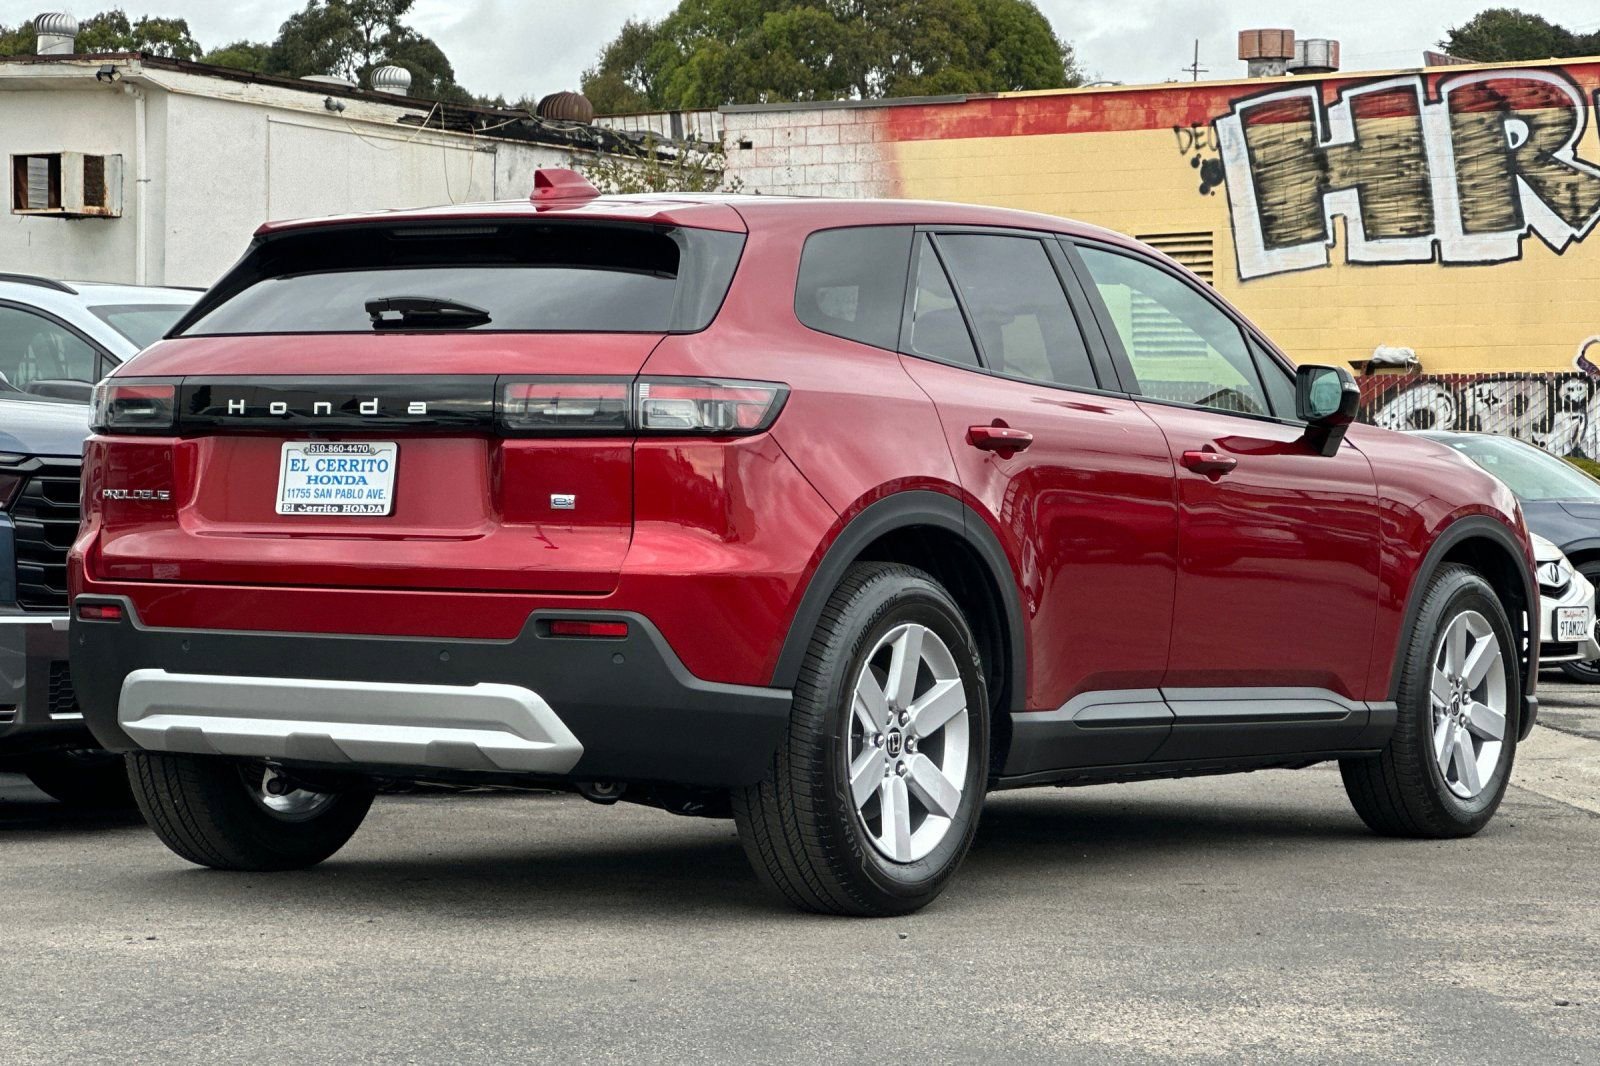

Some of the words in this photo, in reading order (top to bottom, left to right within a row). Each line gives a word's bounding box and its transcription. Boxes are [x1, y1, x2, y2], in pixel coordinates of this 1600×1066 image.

[227, 397, 427, 415] Honda
[310, 444, 368, 453] 510-860-4470
[290, 458, 310, 472] EL
[315, 458, 389, 473] CERRITO
[306, 475, 368, 485] HONDA
[102, 489, 170, 500] PROLOGUE
[287, 488, 310, 499] 11755
[314, 488, 332, 499] SAN
[334, 488, 364, 499] PABLO
[366, 488, 386, 500] AVE.
[282, 504, 295, 512] El
[297, 504, 339, 512] Cerrito
[342, 504, 384, 513] HONDA
